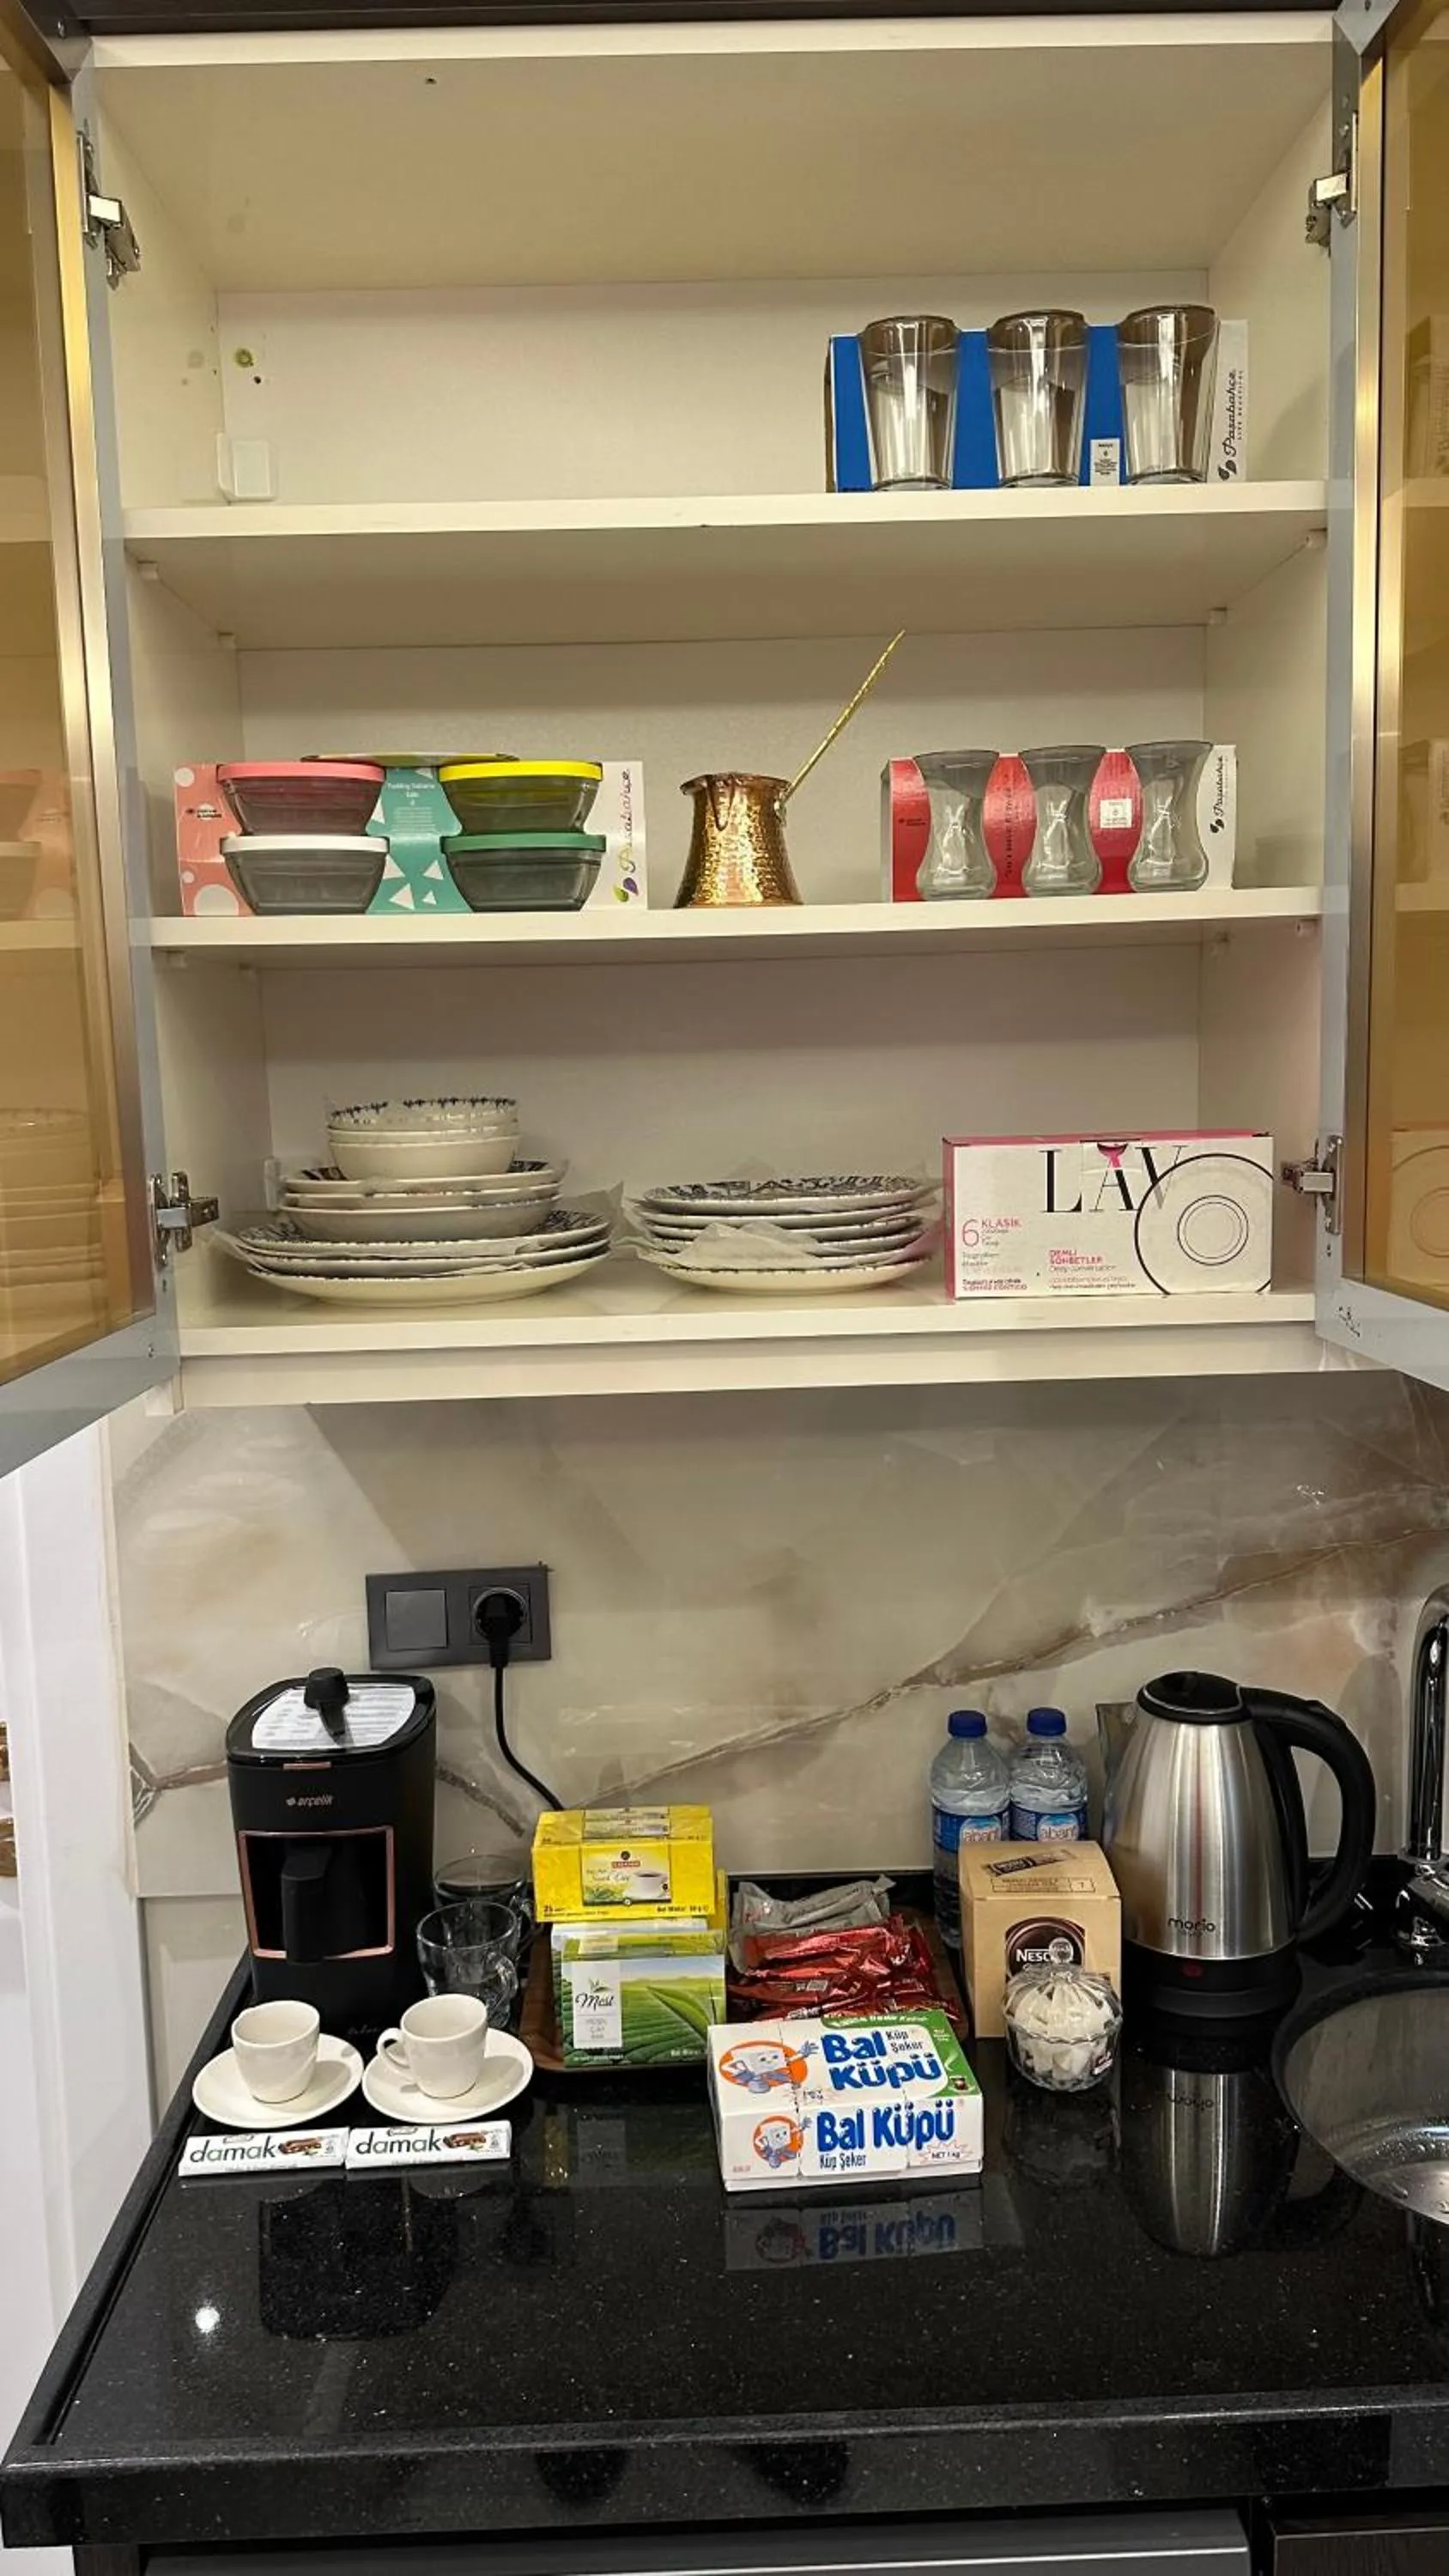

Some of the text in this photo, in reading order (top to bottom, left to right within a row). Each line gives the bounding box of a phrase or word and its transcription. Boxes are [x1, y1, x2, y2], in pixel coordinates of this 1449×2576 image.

[1040, 1144, 1185, 1213] LAV
[962, 1218, 979, 1248] 6
[1016, 1948, 1063, 1963] NESC
[822, 2031, 887, 2064] Bal
[886, 2031, 909, 2041] Küp
[829, 2053, 942, 2091] Küpü
[816, 2098, 954, 2152] Bal Küpü
[190, 2136, 276, 2163] damak
[355, 2128, 441, 2154] damak
[820, 2151, 867, 2171] Küp Şeker
